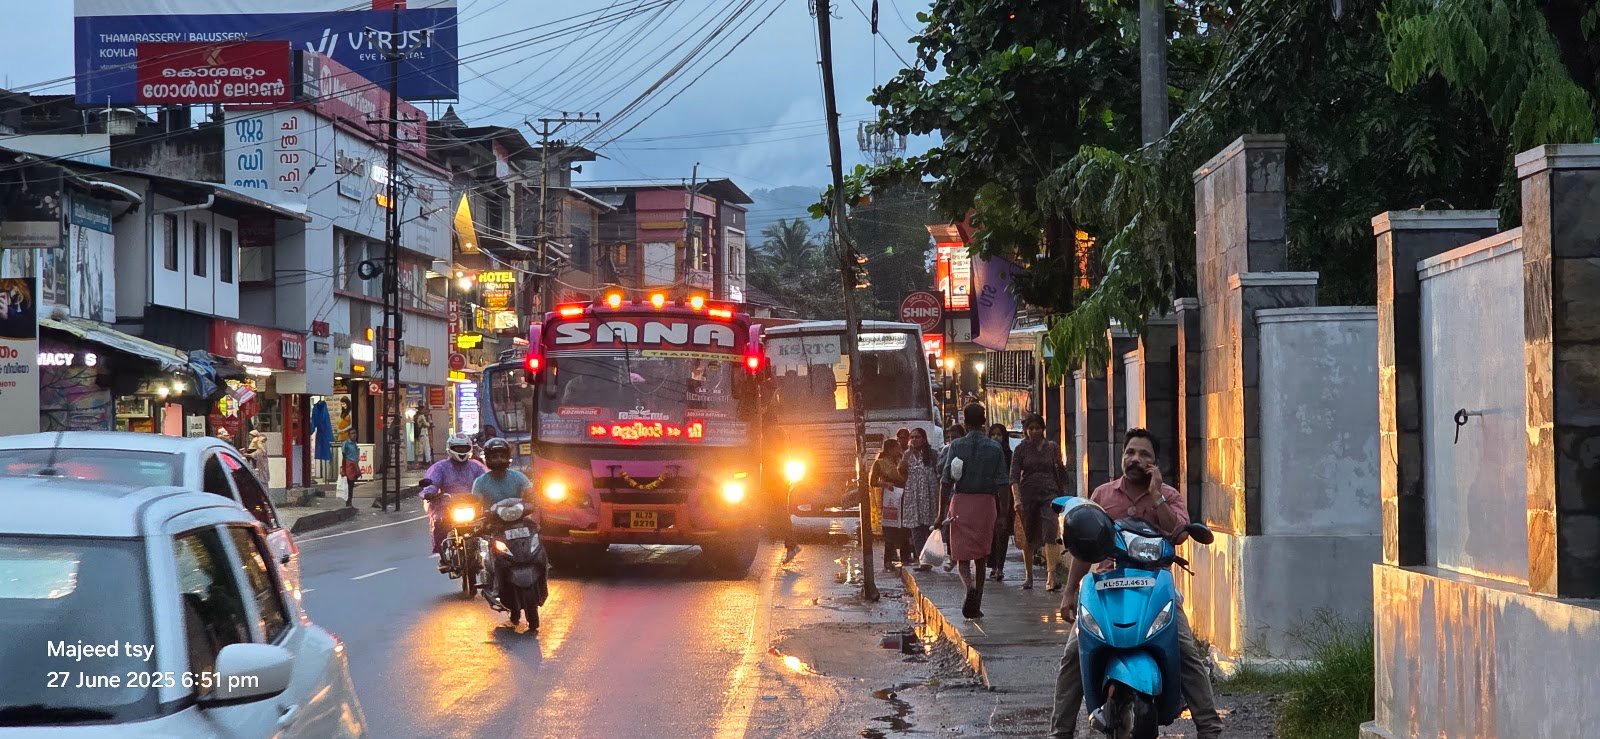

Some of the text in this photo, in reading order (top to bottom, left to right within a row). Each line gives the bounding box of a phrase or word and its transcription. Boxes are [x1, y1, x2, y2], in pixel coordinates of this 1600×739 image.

[100, 32, 249, 43] THAMARASSERY BALUSSERY
[100, 48, 138, 58] KOYILA
[143, 79, 285, 98] ഗോൾഡ് ലോൺ
[478, 271, 516, 283] HOTEL
[902, 307, 939, 317] SHINE
[449, 301, 459, 355] HOTEL
[555, 321, 735, 347] SANA
[650, 351, 740, 361] TRANSPORT
[778, 343, 835, 357] KSRTC
